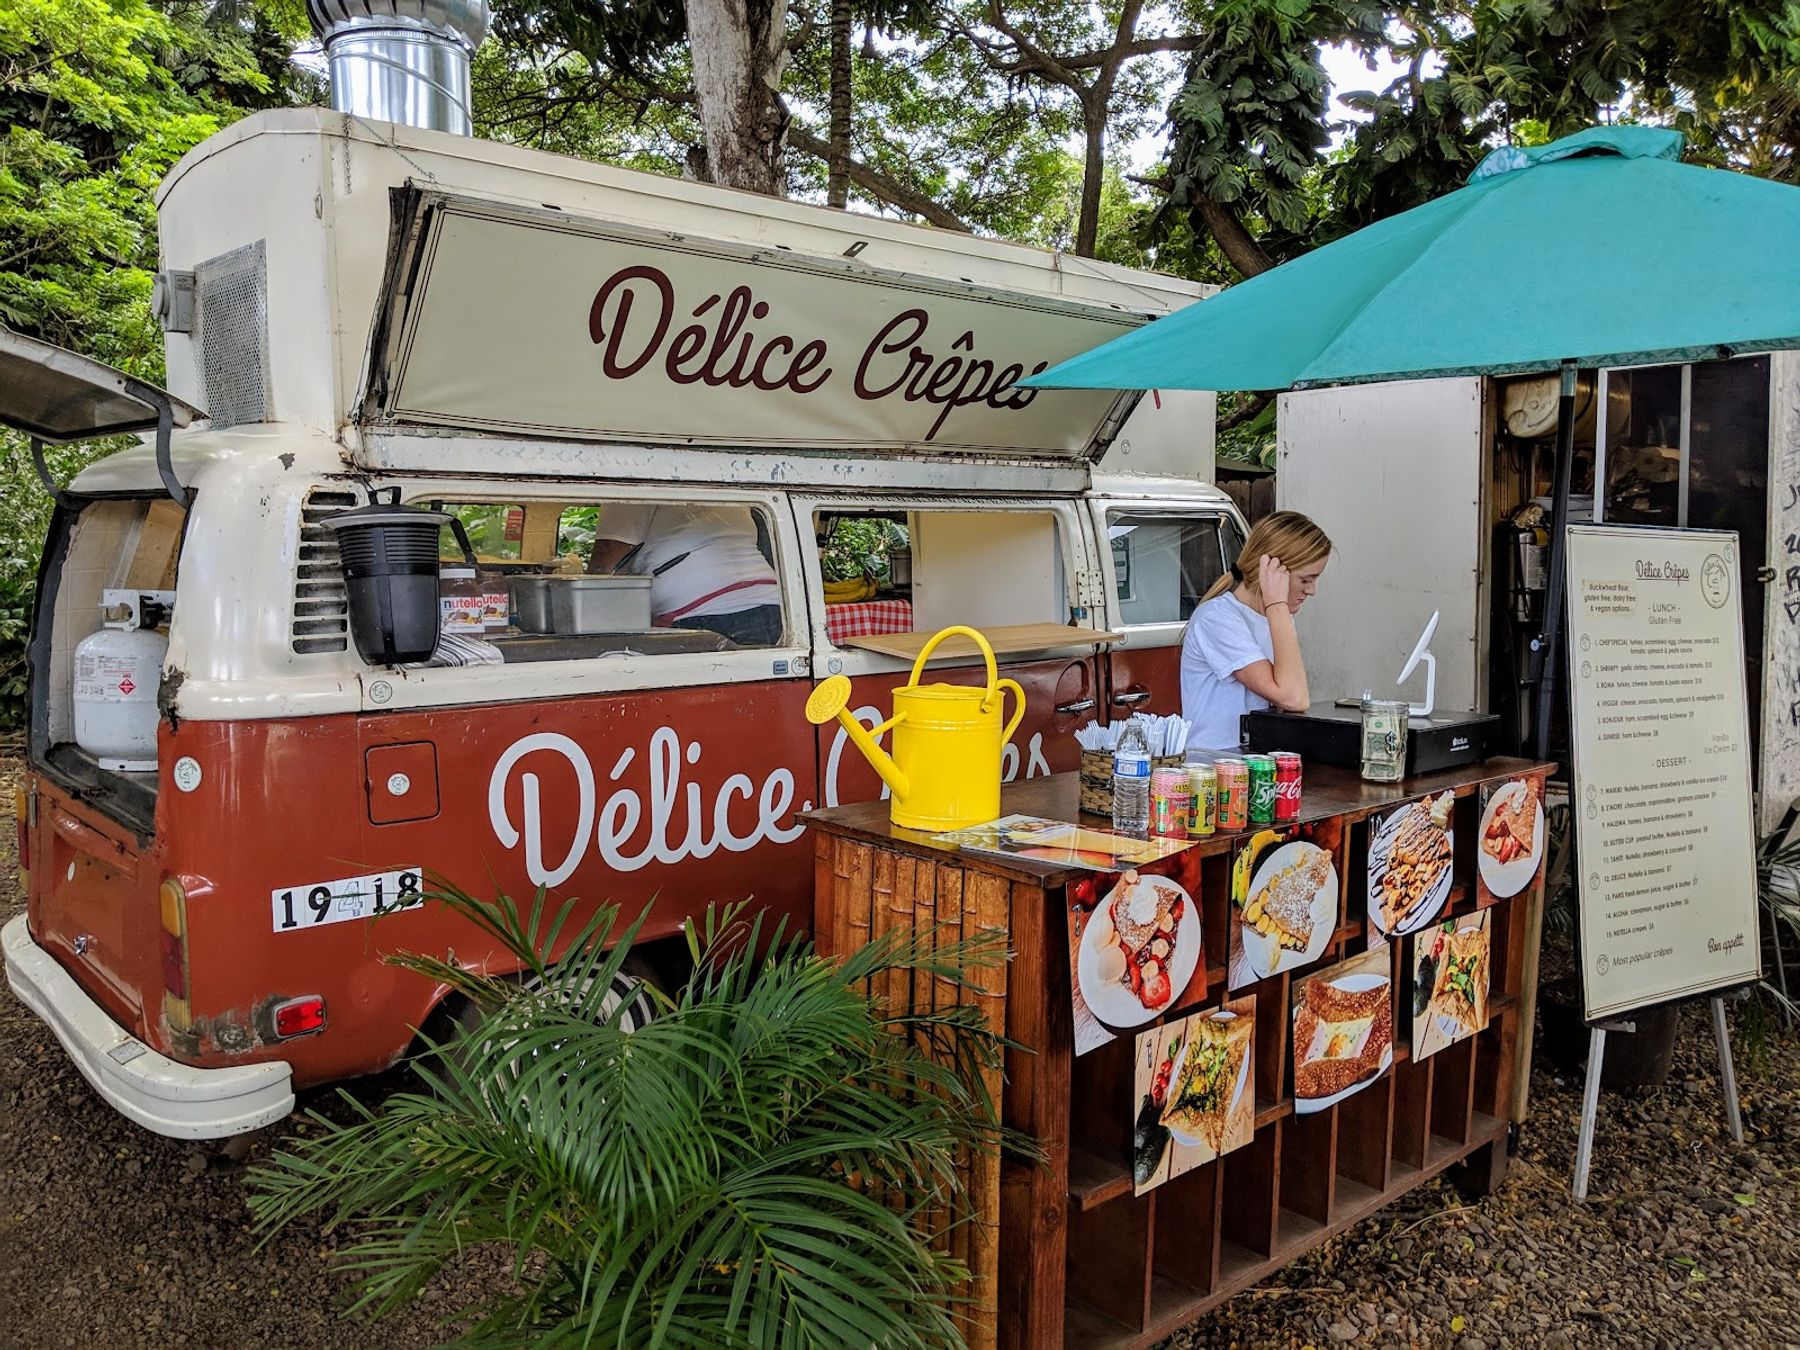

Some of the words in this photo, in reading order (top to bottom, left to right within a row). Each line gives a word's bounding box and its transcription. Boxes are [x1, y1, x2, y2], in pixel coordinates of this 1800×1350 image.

[588, 265, 832, 393] Délice
[854, 308, 1049, 441] Crêpes
[1635, 560, 1662, 578] Délice
[1664, 561, 1690, 587] Crêpes
[444, 596, 482, 608] nutella
[483, 594, 508, 604] utella
[1653, 604, 1676, 612] LUNCH
[1648, 616, 1668, 624] Gluten
[1669, 616, 1681, 624] Free
[1656, 756, 1687, 768] DESSERT
[488, 726, 813, 888] Délice
[1613, 958, 1628, 966] Most
[1630, 952, 1652, 965] popular
